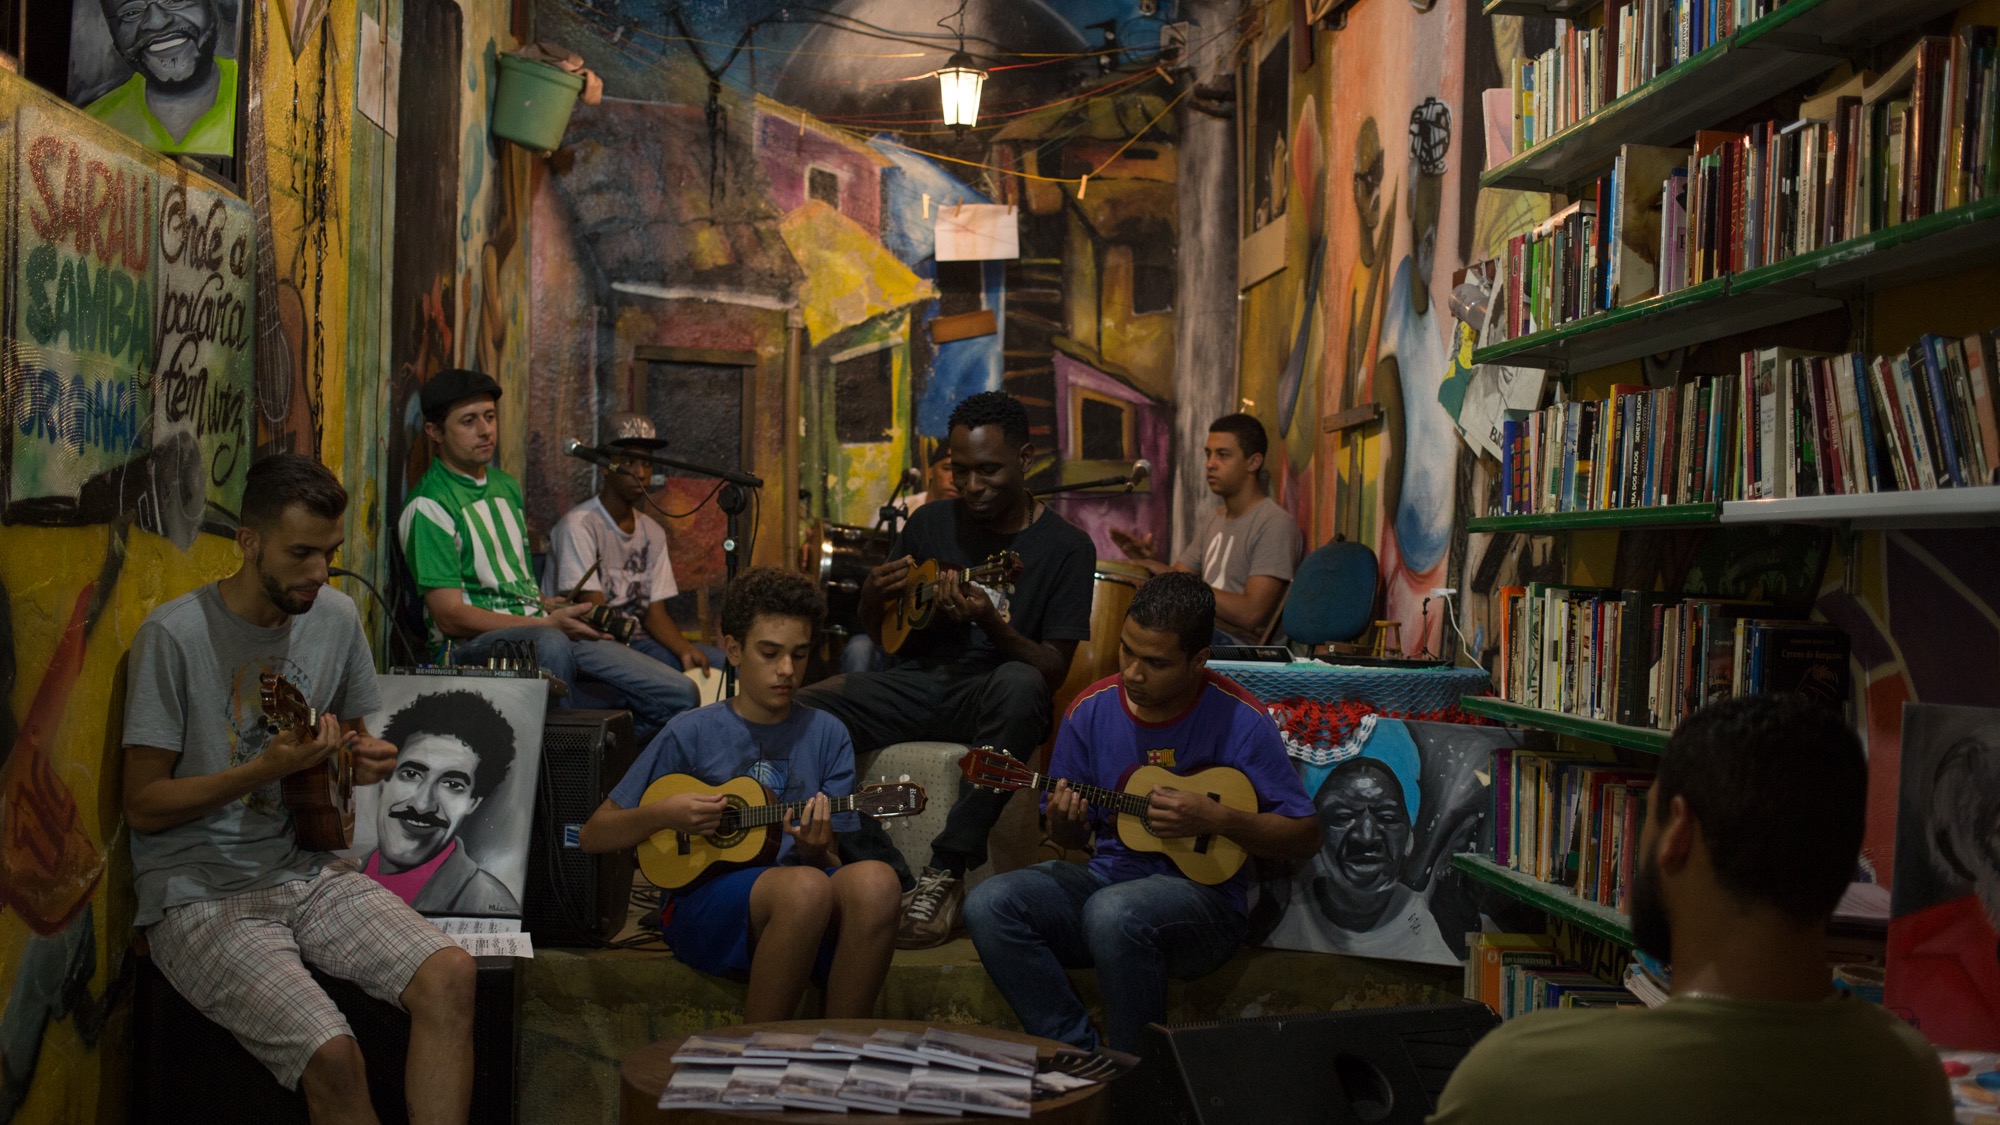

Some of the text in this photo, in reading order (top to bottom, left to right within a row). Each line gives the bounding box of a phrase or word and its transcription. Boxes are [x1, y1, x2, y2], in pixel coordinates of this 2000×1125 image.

[29, 136, 150, 274] SARAU
[161, 187, 249, 277] Onde a
[1731, 153, 1740, 236] NERUDA
[26, 244, 151, 365] SAMBA
[162, 273, 249, 352] palavra
[162, 334, 208, 439] tem
[415, 667, 458, 676] BEHRINGER
[1781, 650, 1843, 663] Cyrano de Bergerac
